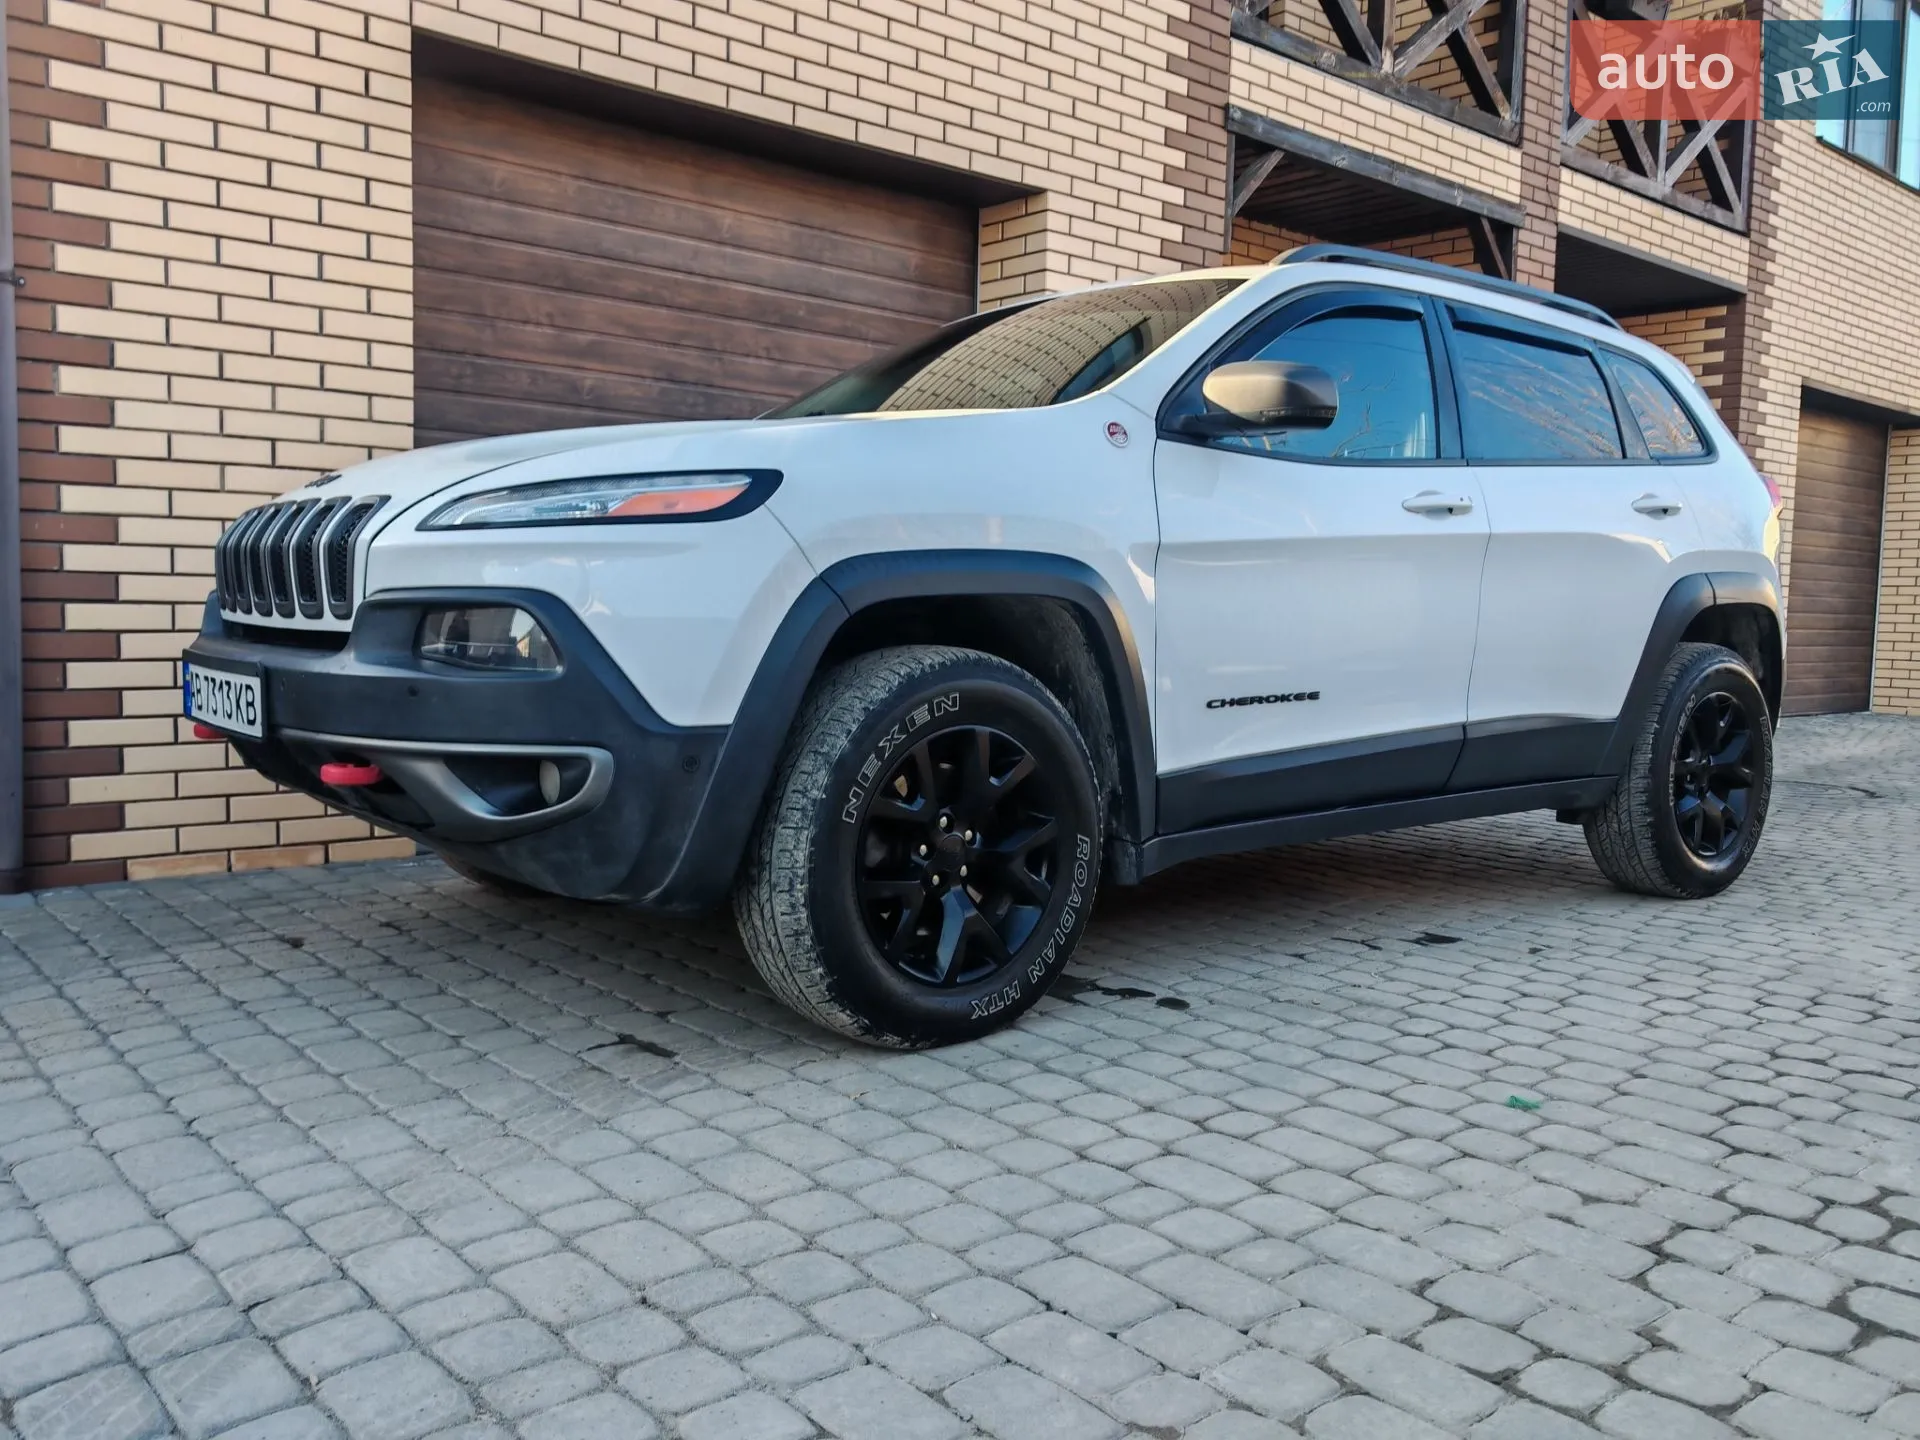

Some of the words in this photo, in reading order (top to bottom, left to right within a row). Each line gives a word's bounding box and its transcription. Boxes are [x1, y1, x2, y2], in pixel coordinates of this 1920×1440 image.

[1206, 691, 1320, 709] CHEROKEE
[841, 692, 960, 824] NEXEN
[1027, 833, 1091, 984] ROADIAN
[970, 979, 1021, 1020] HTX
